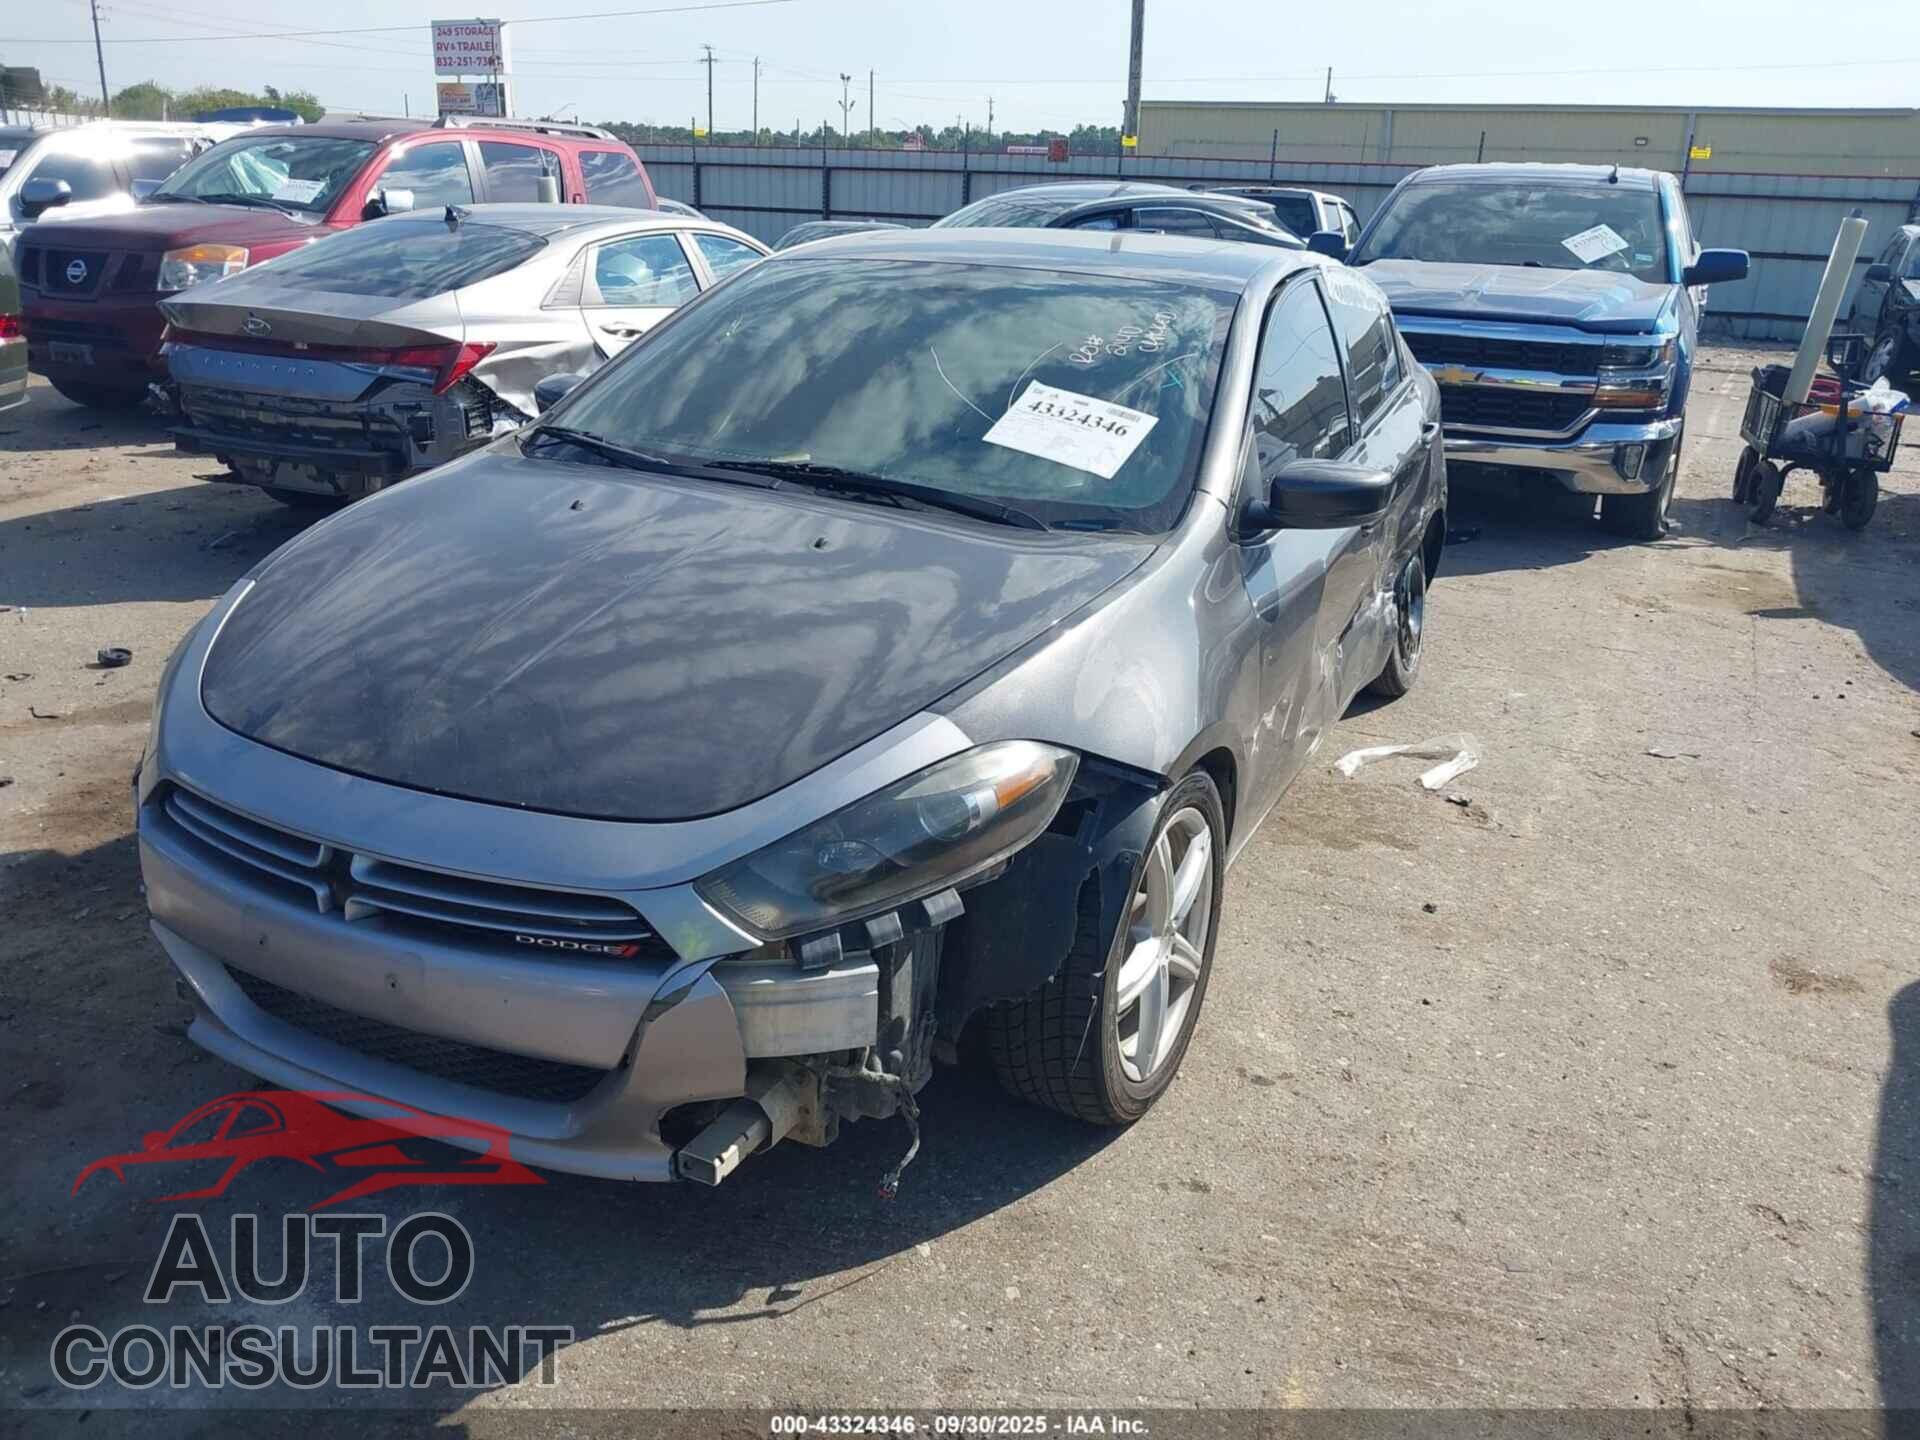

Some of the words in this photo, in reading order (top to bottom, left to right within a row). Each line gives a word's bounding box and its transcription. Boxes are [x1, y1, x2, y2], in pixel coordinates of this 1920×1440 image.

[454, 26, 496, 36] STORAGE
[436, 42, 449, 51] RV
[1028, 400, 1129, 437] 43324346
[515, 934, 623, 954] DODGE
